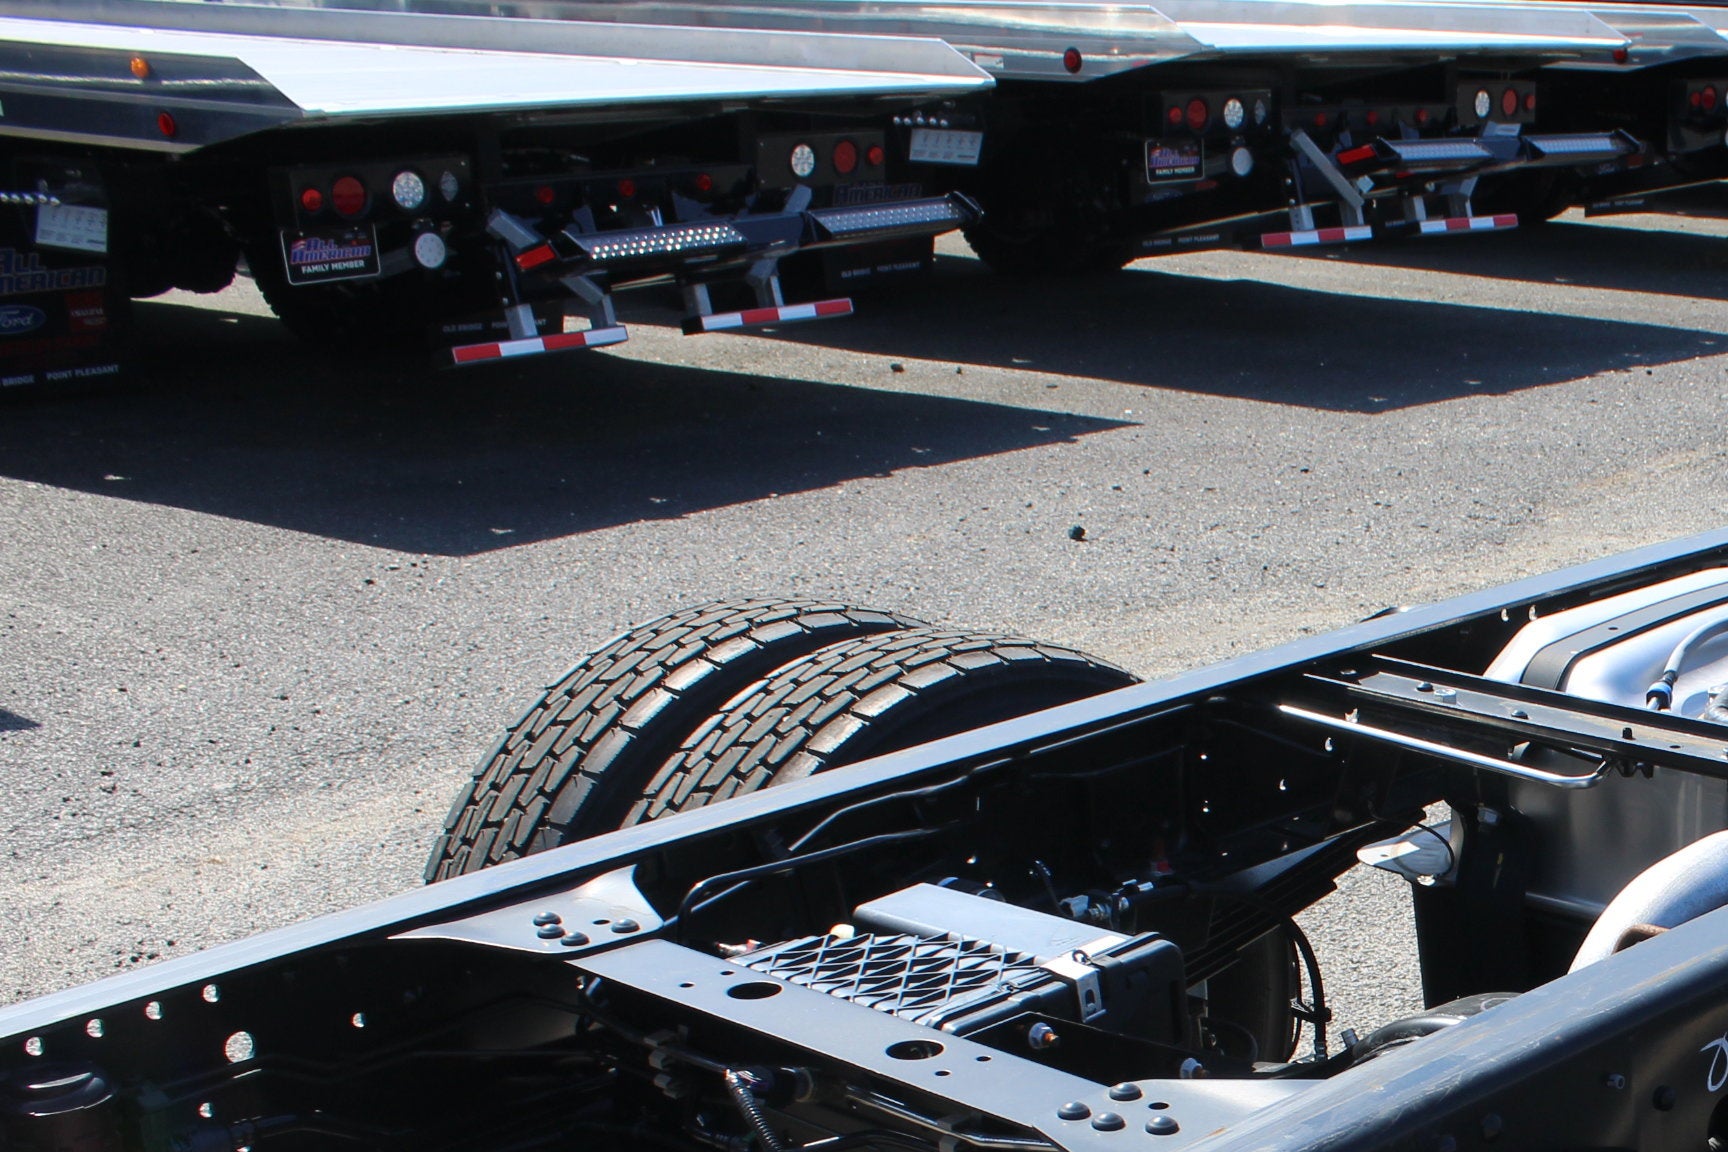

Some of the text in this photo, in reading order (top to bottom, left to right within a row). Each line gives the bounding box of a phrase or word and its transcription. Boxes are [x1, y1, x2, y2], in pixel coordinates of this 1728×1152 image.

[301, 259, 366, 274] FAMILY MEMBER
[1, 363, 120, 387] BRIDGE POINT PLEASANT
